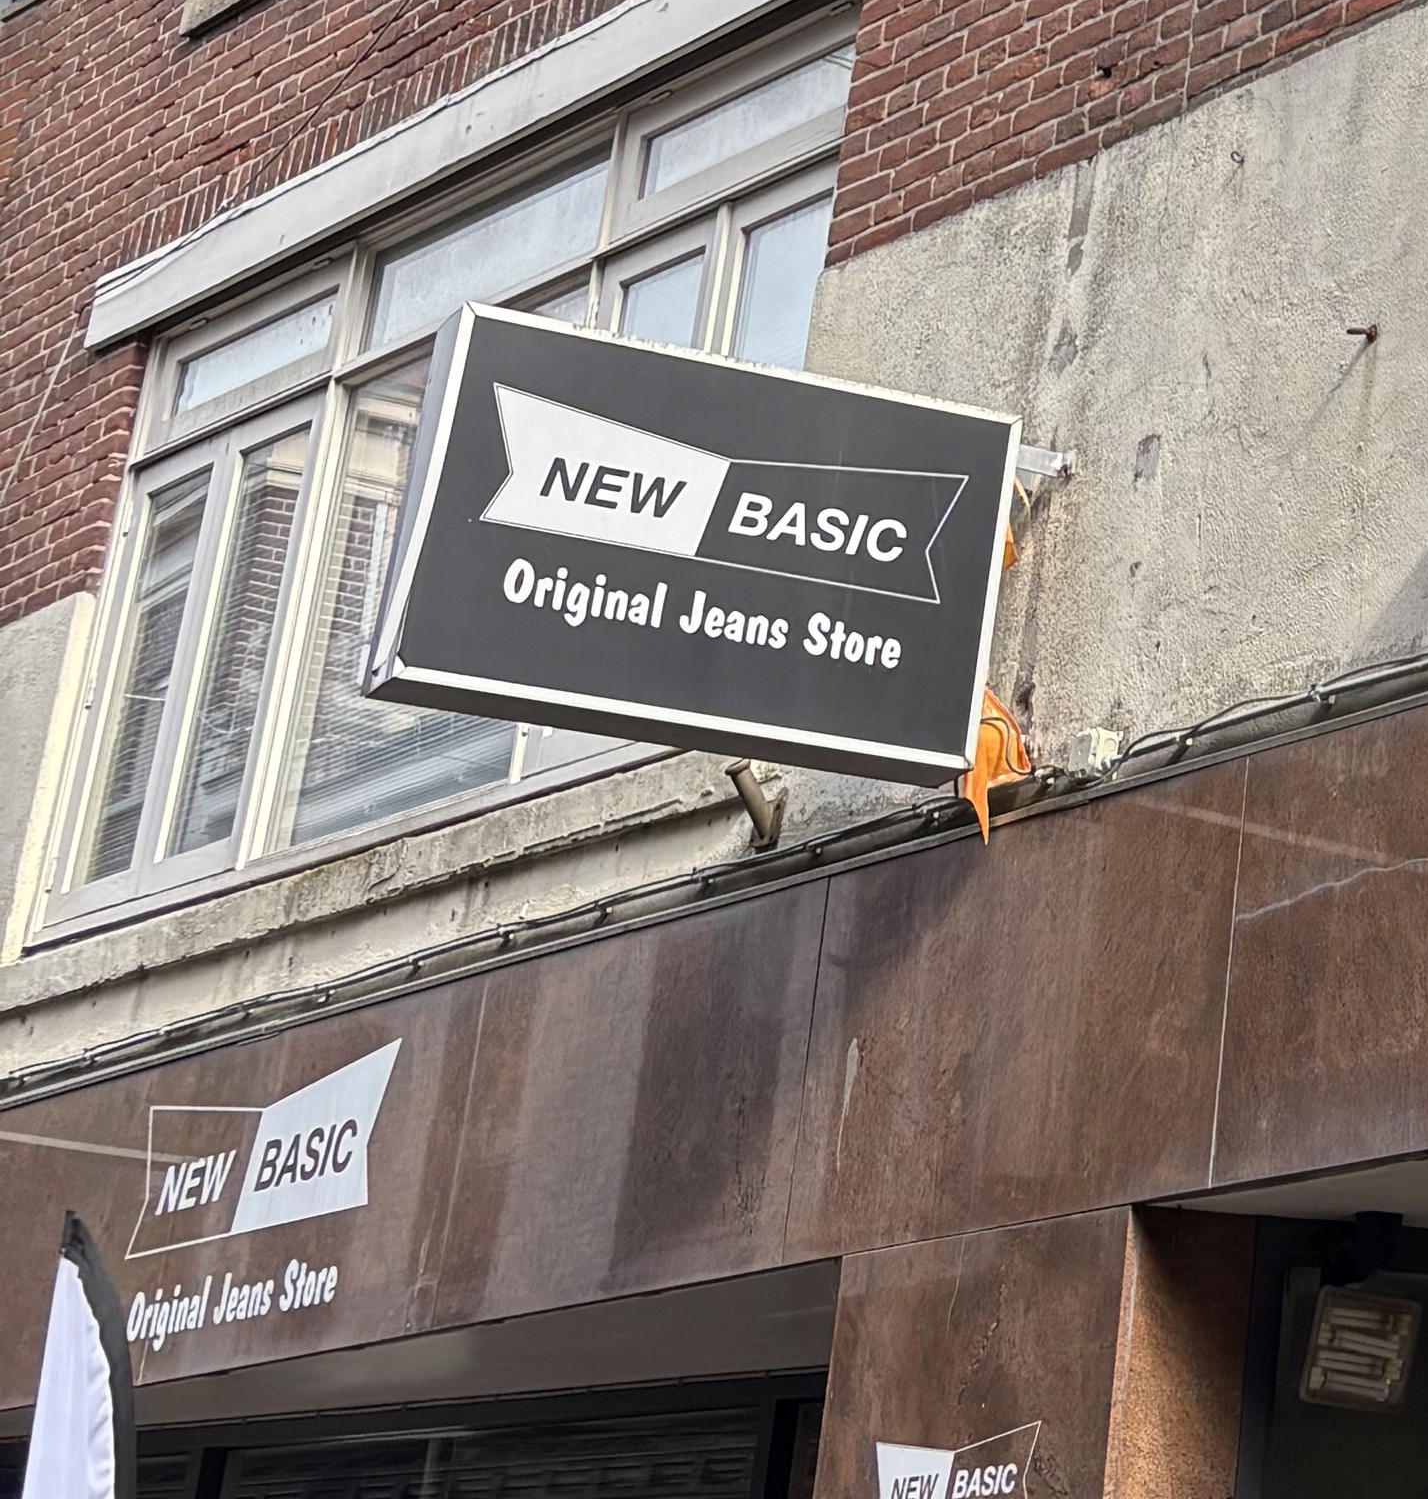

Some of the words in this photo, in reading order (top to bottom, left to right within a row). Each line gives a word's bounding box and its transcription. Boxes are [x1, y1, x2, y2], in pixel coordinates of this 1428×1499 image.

[539, 457, 687, 518] NEW
[728, 492, 908, 562] BASIC
[503, 558, 667, 628] Original
[679, 591, 788, 649] Jeans
[803, 612, 902, 669] Store
[155, 1150, 236, 1216] NEW
[253, 1119, 358, 1192] BASIC
[126, 1275, 213, 1352] Original
[213, 1273, 275, 1325] Jeans
[279, 1259, 338, 1313] Store
[891, 1473, 939, 1499] NEW
[952, 1463, 1018, 1499] BASIC
